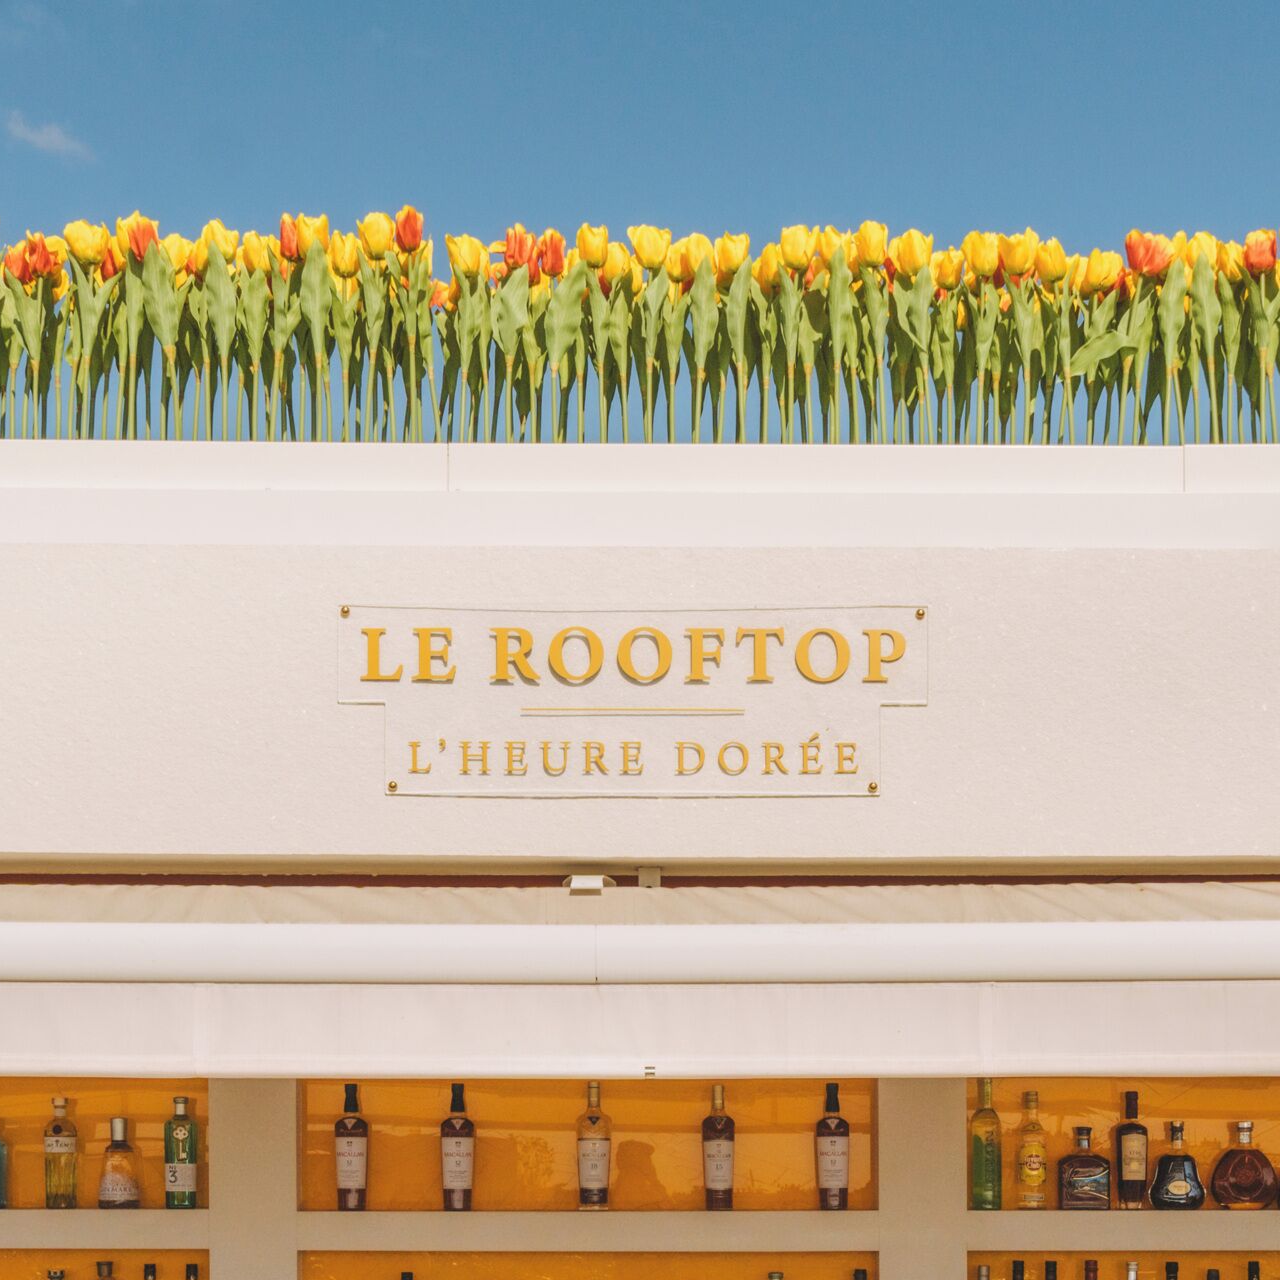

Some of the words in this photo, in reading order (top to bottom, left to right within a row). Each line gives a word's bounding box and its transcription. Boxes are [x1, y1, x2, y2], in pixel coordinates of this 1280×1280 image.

[360, 627, 457, 683] LE
[489, 625, 907, 684] ROOFTOP
[675, 732, 860, 776] DORÉE
[168, 1170, 178, 1183] 3
